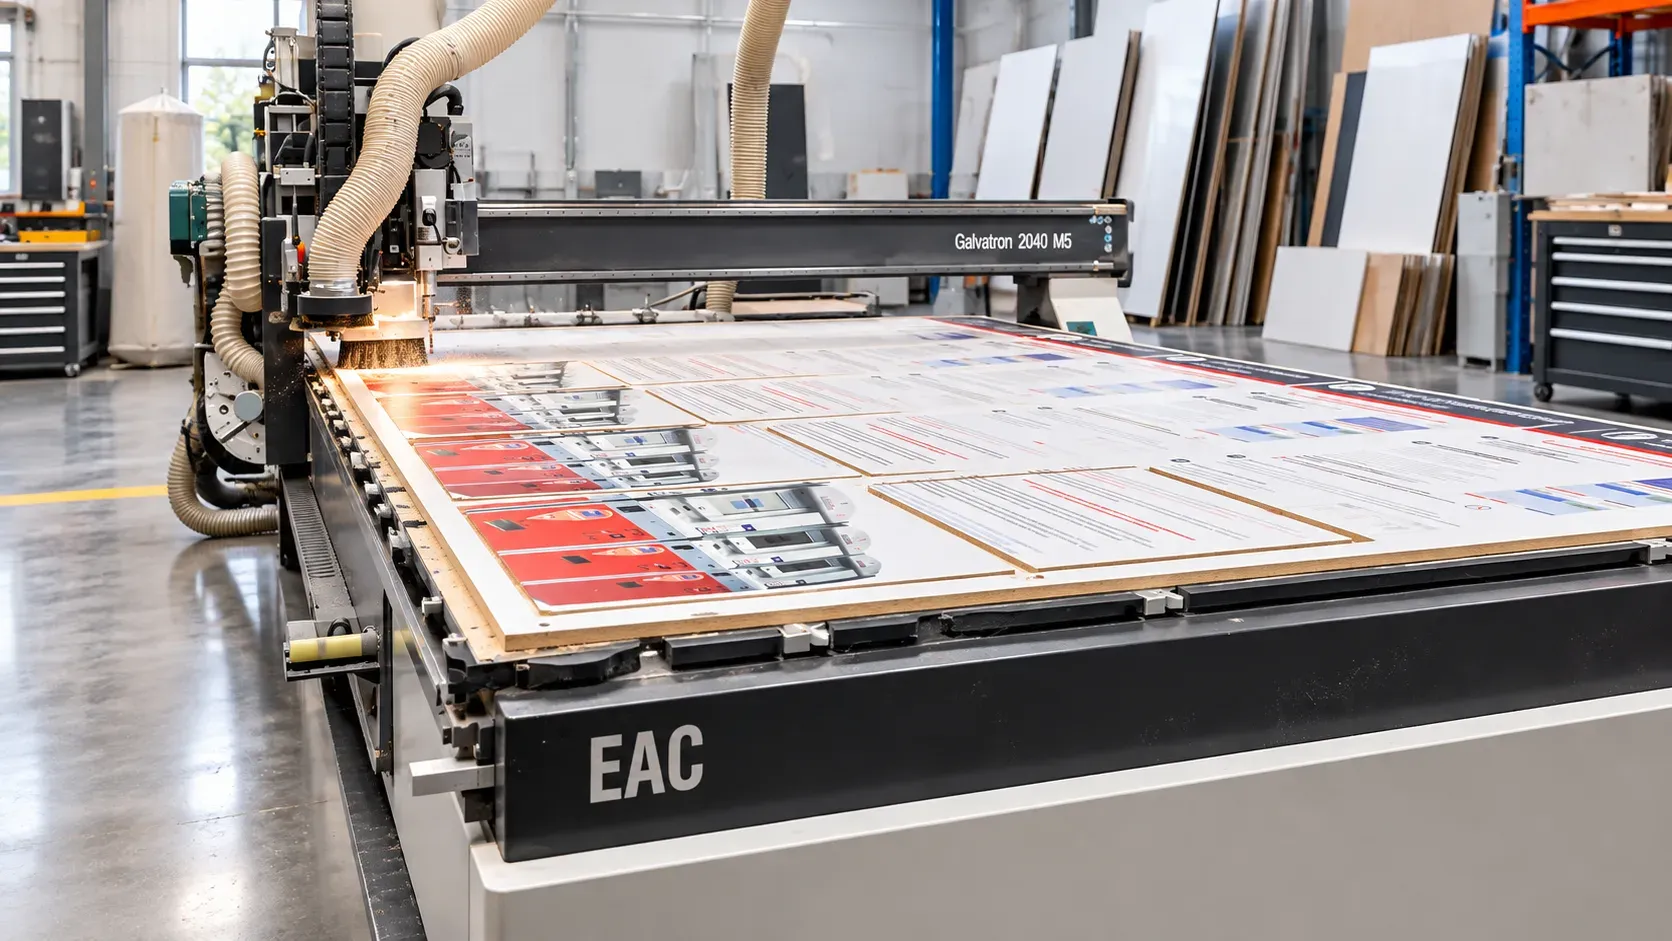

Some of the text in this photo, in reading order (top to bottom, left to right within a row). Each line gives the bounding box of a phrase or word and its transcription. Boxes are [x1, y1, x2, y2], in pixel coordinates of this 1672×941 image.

[954, 232, 1073, 250] Galvatron 2040 M5
[590, 724, 704, 804] EAC
